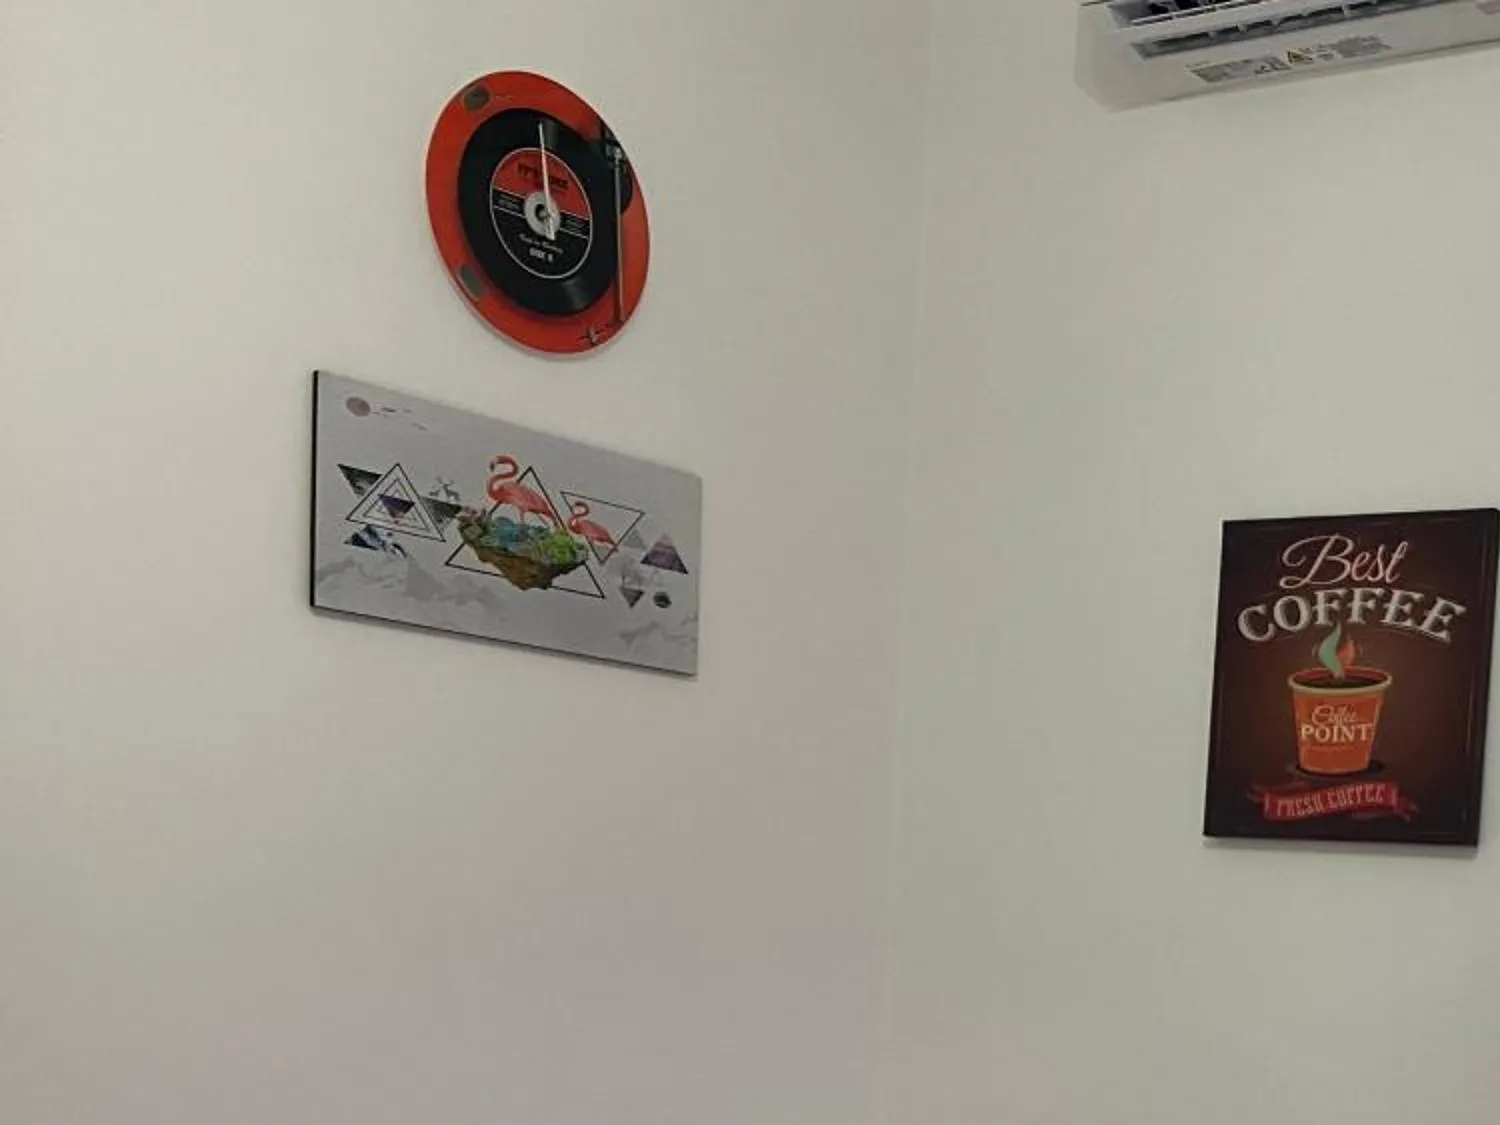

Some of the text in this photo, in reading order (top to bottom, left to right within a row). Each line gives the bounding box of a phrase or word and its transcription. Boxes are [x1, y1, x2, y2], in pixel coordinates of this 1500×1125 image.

[1279, 533, 1408, 589] Best
[1237, 587, 1467, 643] COFFEE
[1299, 723, 1374, 743] POINT
[1327, 783, 1386, 810] COFFEE
